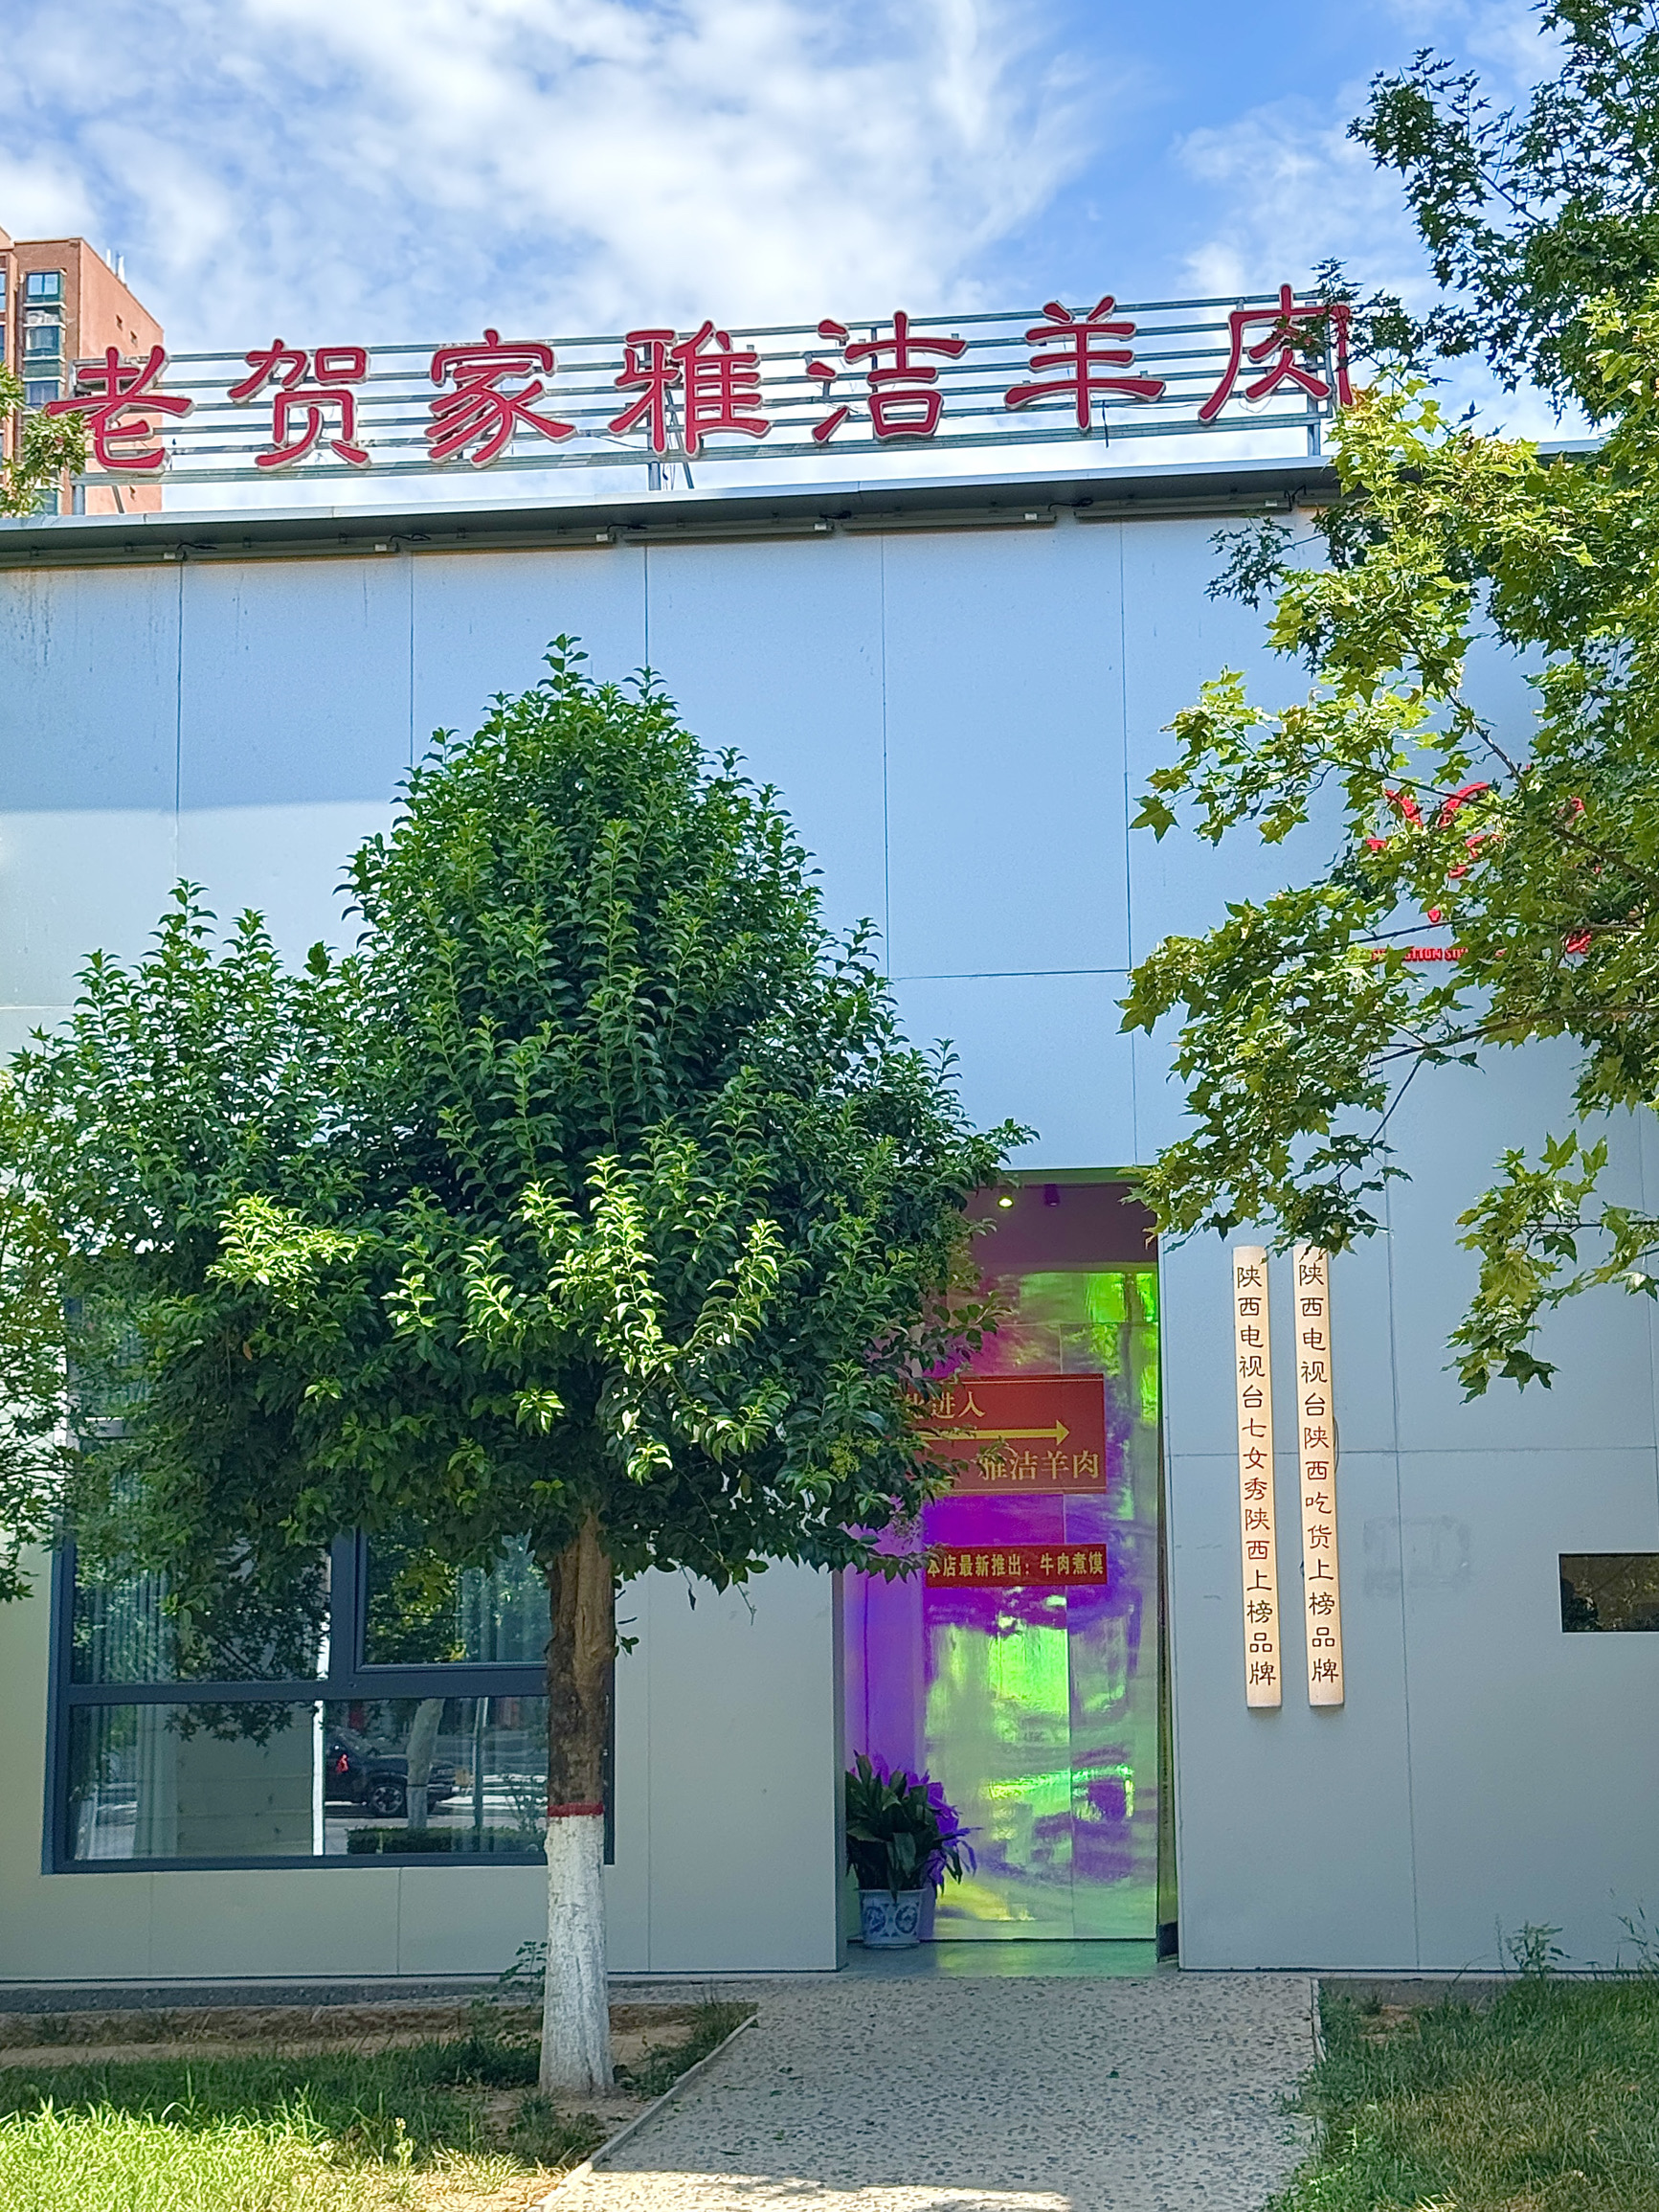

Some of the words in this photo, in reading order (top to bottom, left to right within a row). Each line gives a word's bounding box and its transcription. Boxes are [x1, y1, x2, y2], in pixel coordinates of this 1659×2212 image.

[46, 283, 1354, 473] 老贺家雅洁羊肉
[1237, 1264, 1276, 1686] 陕西电视台七女秀陕西上榜品牌
[1299, 1262, 1339, 1683] 陕西电视台陕西吃货上榜品牌
